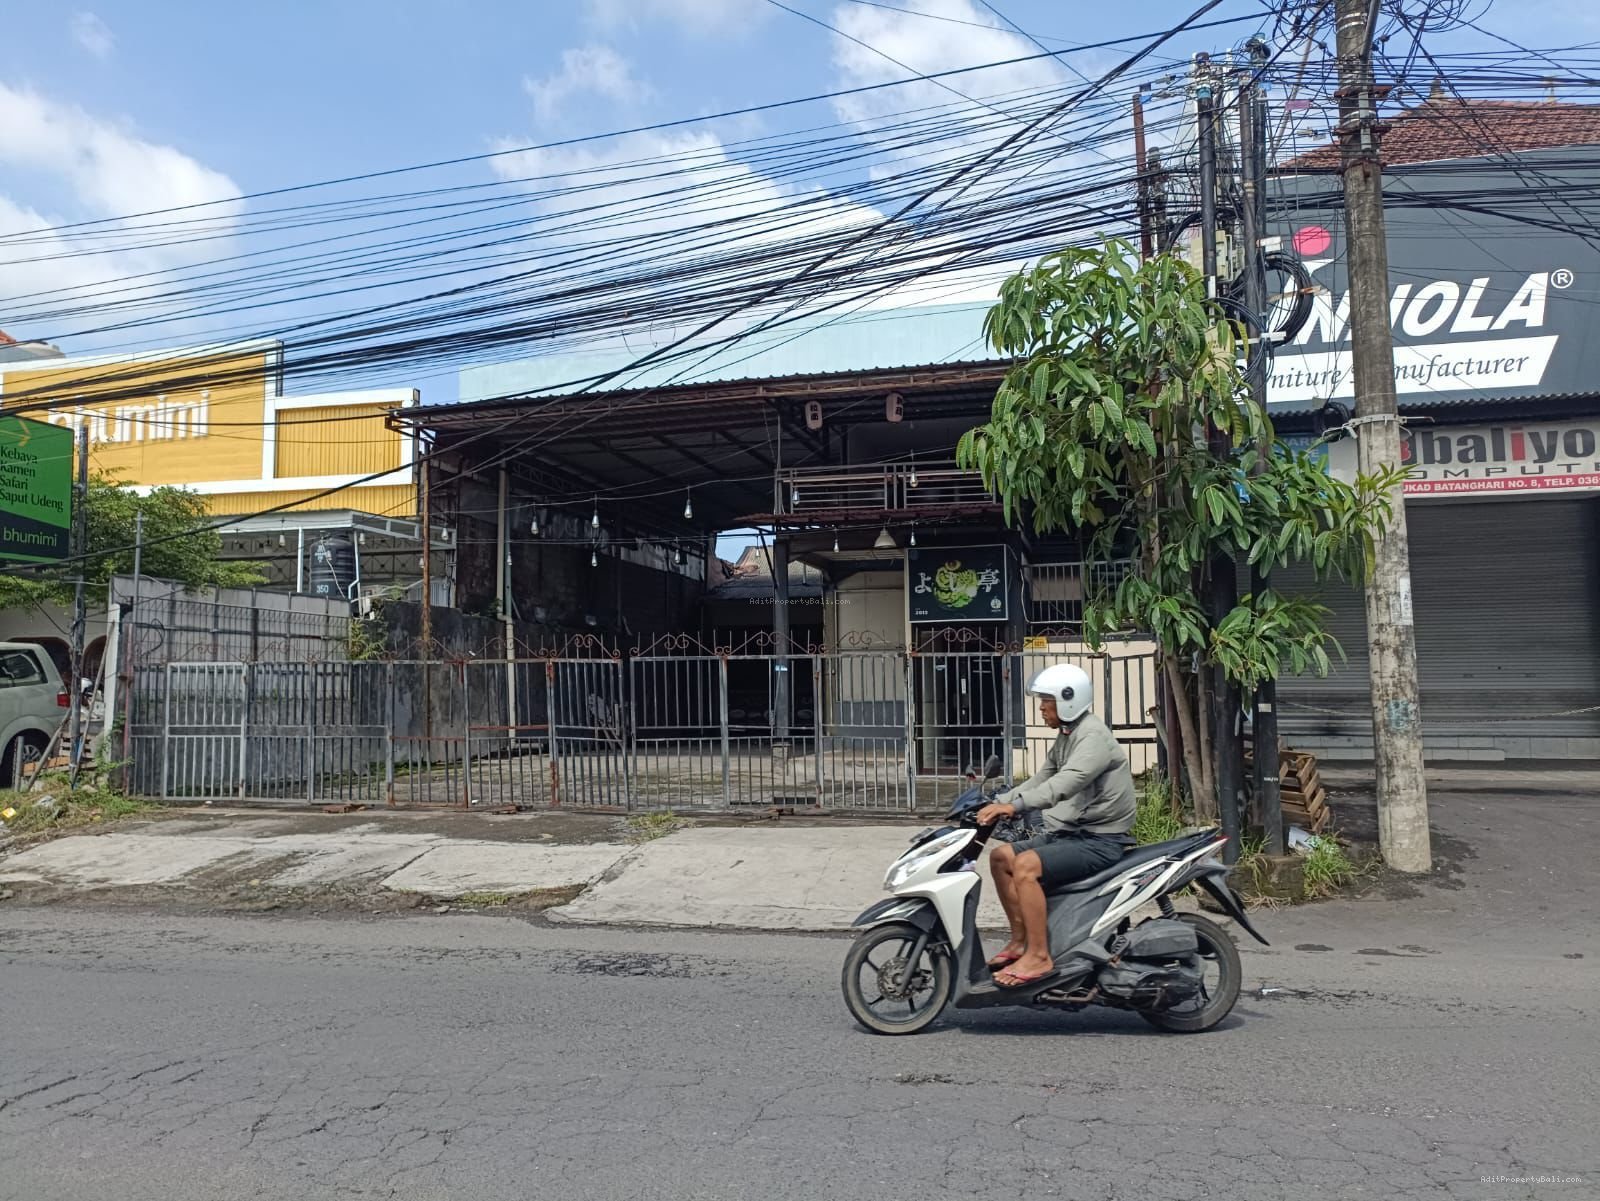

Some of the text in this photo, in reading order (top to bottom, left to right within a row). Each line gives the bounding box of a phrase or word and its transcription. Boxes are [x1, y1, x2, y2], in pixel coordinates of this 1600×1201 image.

[1271, 354, 1529, 389] niture nufacturer
[0, 446, 38, 465] Kebaya
[0, 460, 36, 478] Kamen
[1404, 462, 1600, 480] OMPUT
[0, 475, 29, 490] Safari
[1434, 481, 1505, 491] BATANGHARI
[1508, 480, 1528, 488] NO.
[1530, 479, 1541, 488] 8,
[1544, 477, 1575, 487] TELP.
[0, 488, 64, 513] Saput Udeng
[3, 527, 57, 547] bhumimi
